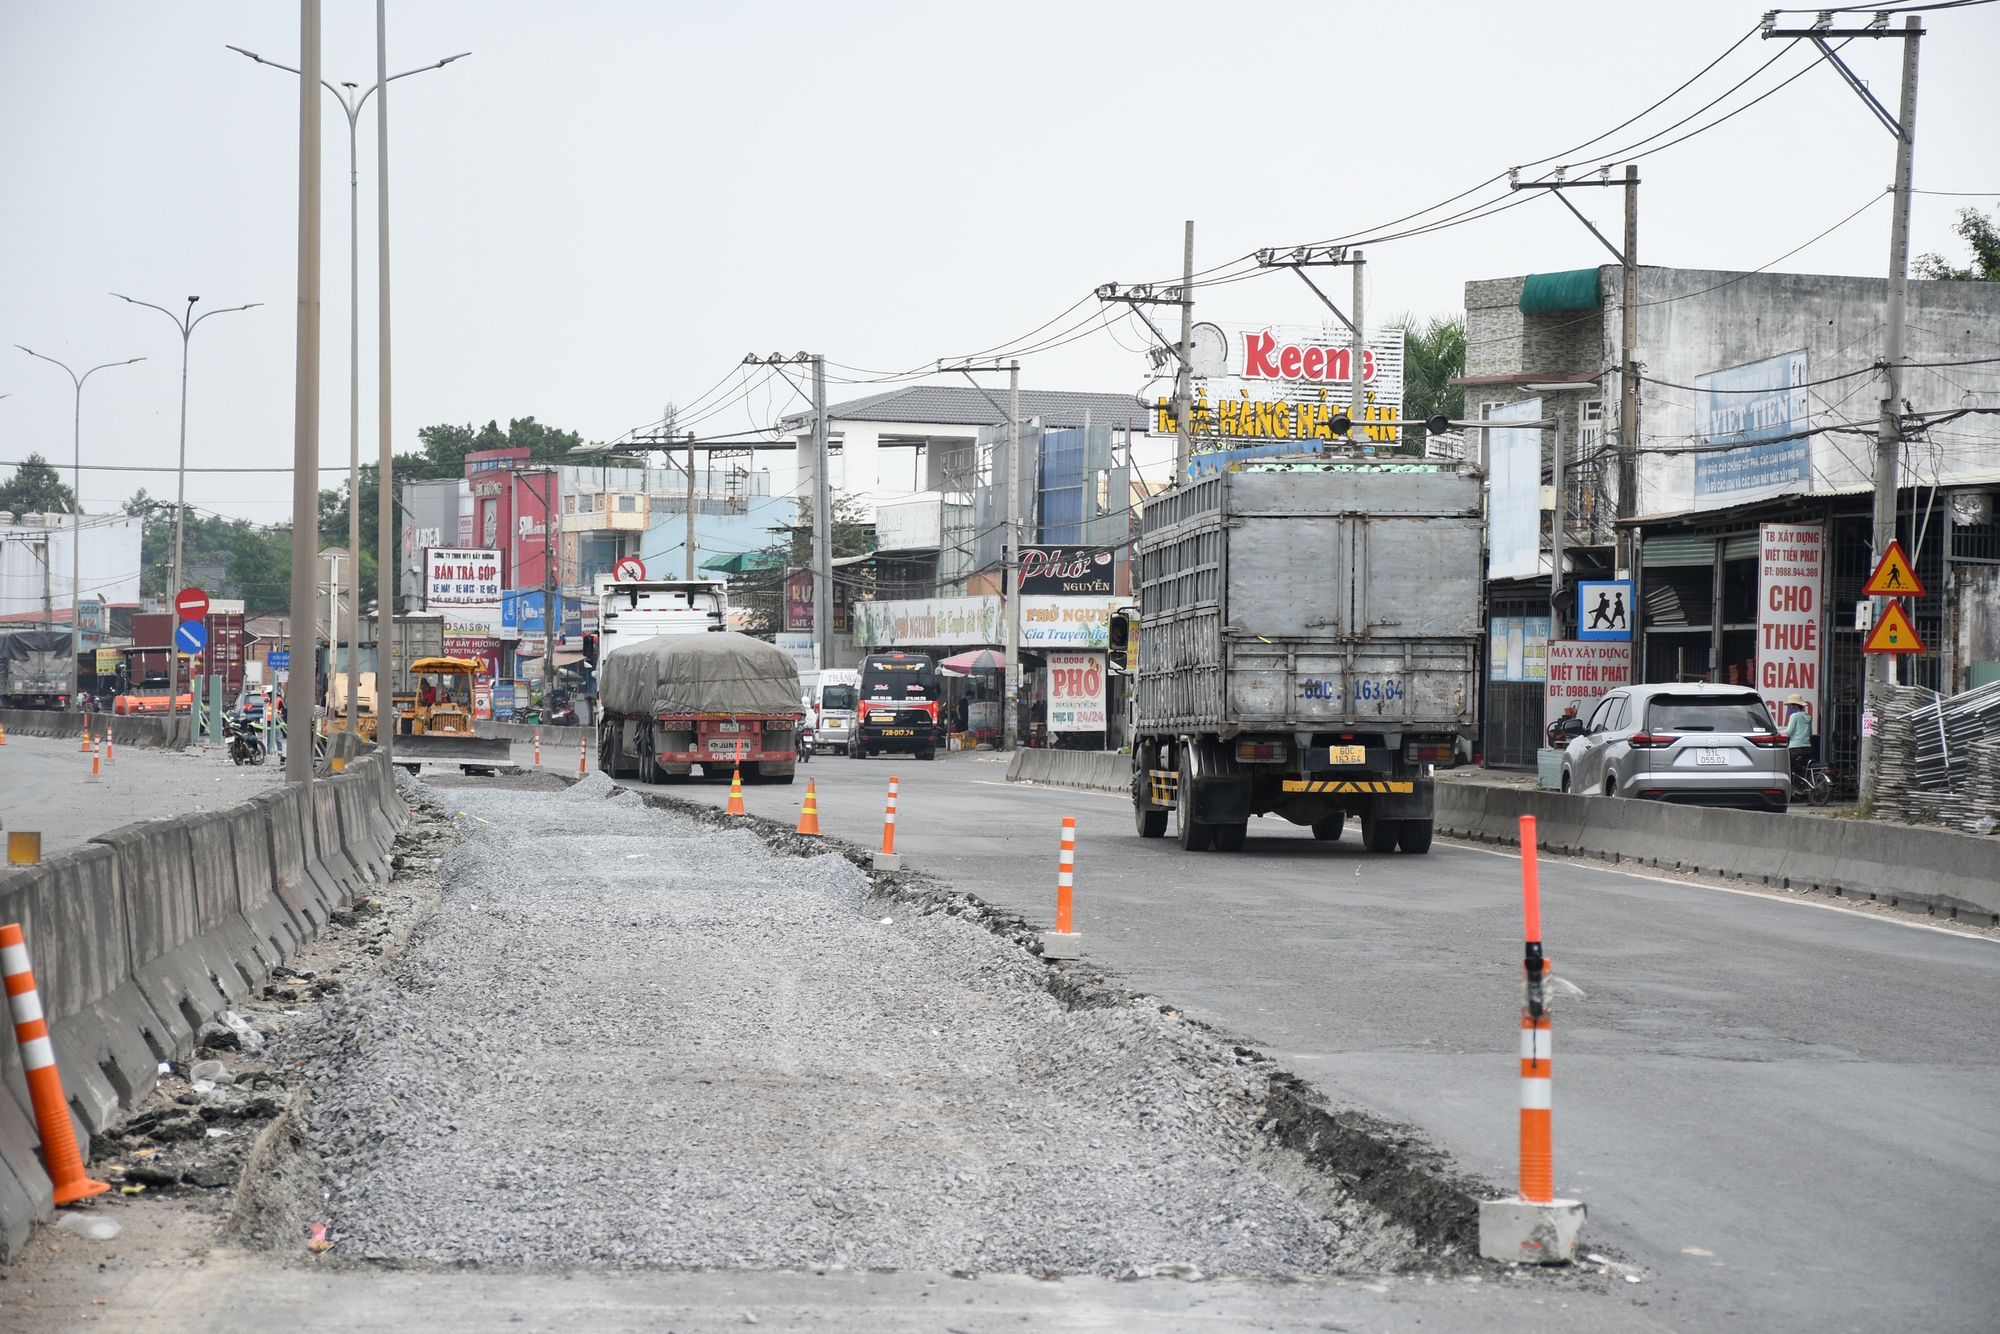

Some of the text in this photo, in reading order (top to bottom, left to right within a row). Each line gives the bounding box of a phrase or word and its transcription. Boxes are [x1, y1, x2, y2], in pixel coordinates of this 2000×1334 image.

[1158, 387, 1211, 433] NÀ
[1219, 389, 1290, 438] HÀNG
[1711, 384, 1789, 438] VIỆT TIẾN
[1765, 531, 1819, 545] TB XÂY DỰNG
[1765, 546, 1819, 563] VIỆT TIẾN PHÁT
[434, 562, 496, 581] BÁN TRẢ GÓP
[1018, 549, 1091, 591] Phở
[1765, 566, 1775, 577] ĐT:
[433, 584, 440, 593] XE
[441, 583, 451, 593] MÁY
[456, 584, 462, 593] XE
[479, 585, 485, 594] XE
[792, 581, 813, 603] RỬ
[1063, 579, 1110, 591] NGUYỄN
[1769, 585, 1813, 613] CHO
[1026, 604, 1059, 622] PHỞ
[453, 623, 490, 631] SAISON
[896, 609, 909, 639] PHỞ
[910, 604, 935, 638] NGUYỄN
[1025, 629, 1044, 640] Gia
[1763, 619, 1816, 651] THUÊ
[456, 639, 470, 647] BẢY
[472, 639, 500, 647] HƯƠNG
[1536, 643, 1547, 658] HIÊ
[1551, 645, 1629, 661] MÁY XÂY DỰNG
[1052, 657, 1101, 698] PHỞ
[1550, 660, 1629, 684] VIỆT TIẾN PHÁT
[1763, 657, 1815, 689] GIÀN
[1355, 680, 1403, 700] 163.64
[1550, 685, 1563, 697] ĐT:
[1056, 700, 1098, 708] NGUYỄN
[1053, 711, 1104, 724] PHỤC VỤ 24/24
[1335, 755, 1361, 763] 163.64
[1706, 749, 1719, 757] 51L
